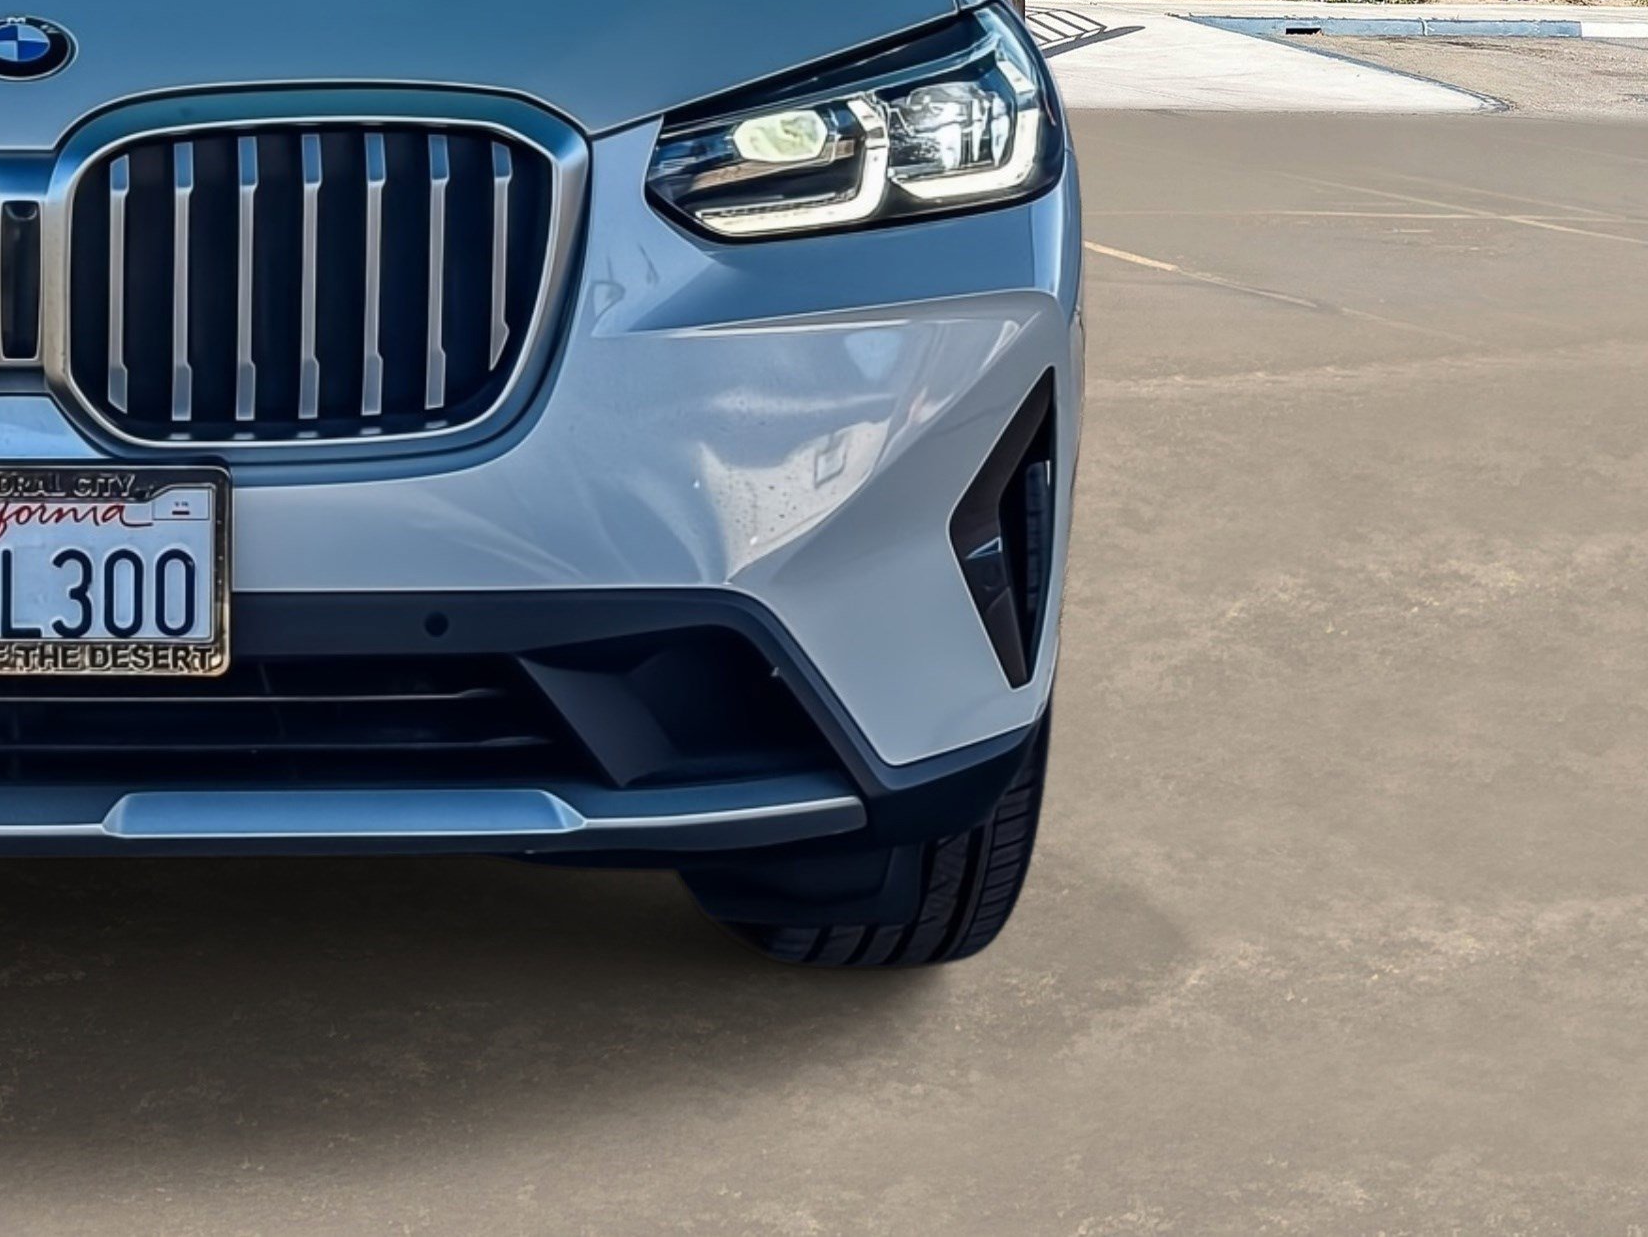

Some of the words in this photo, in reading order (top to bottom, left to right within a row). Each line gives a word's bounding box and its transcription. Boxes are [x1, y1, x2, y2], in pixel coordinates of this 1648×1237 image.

[73, 473, 136, 498] CITY
[12, 645, 80, 671] THE
[86, 645, 214, 671] DESERT
